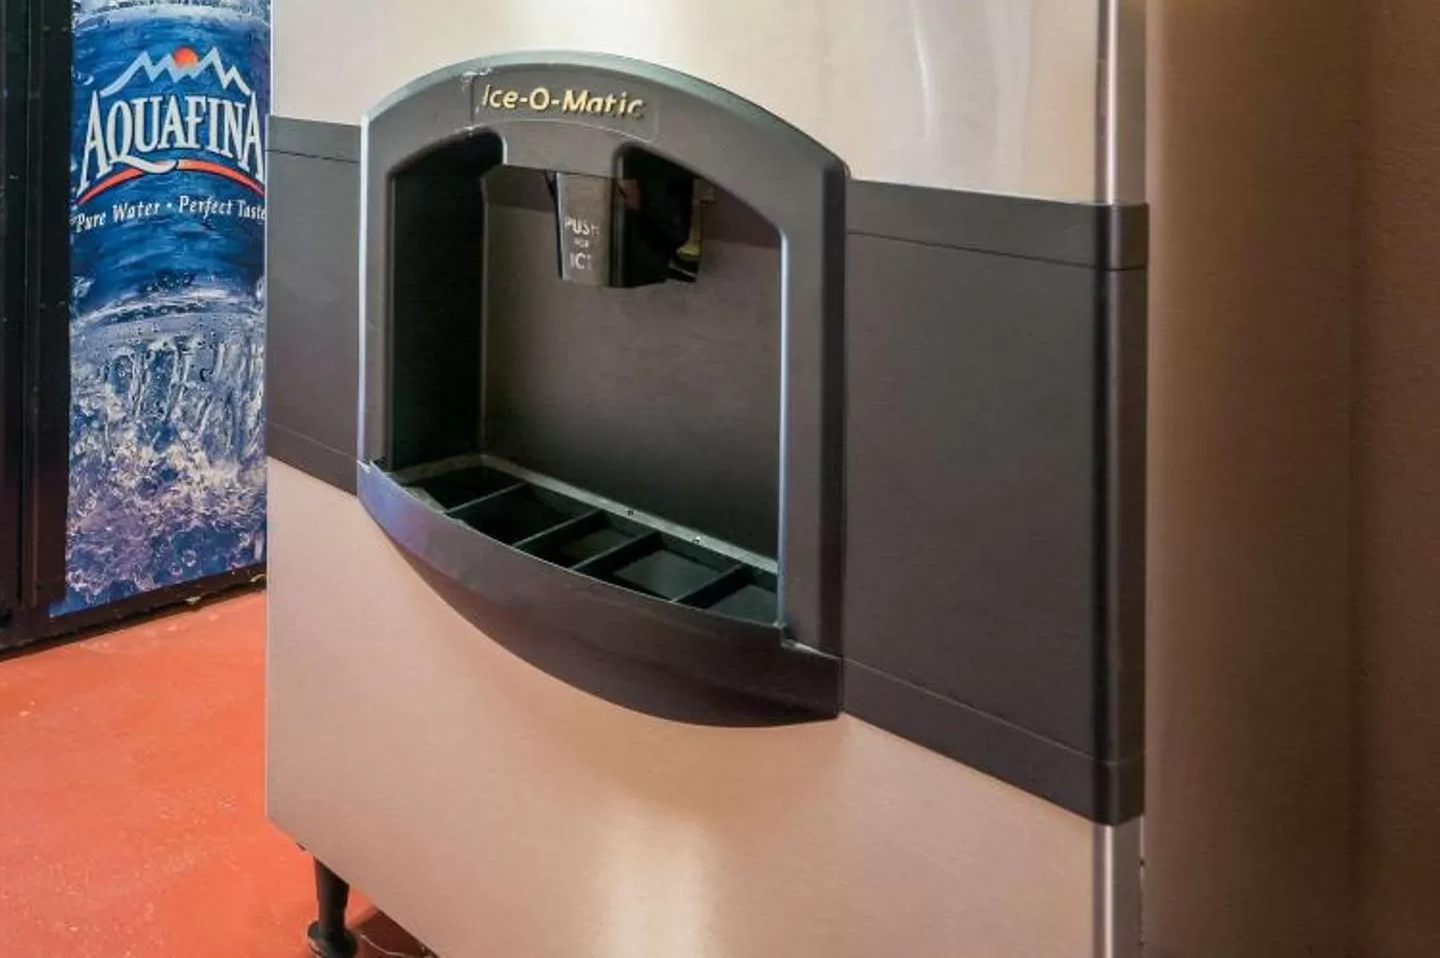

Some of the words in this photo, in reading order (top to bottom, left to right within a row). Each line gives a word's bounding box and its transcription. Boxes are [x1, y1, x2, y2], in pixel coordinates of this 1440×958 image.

[481, 84, 644, 116] Ice-O-Matic
[75, 89, 266, 196] AQUAFINA
[72, 211, 106, 233] Pure
[112, 200, 160, 223] Water
[179, 195, 232, 219] Perfect
